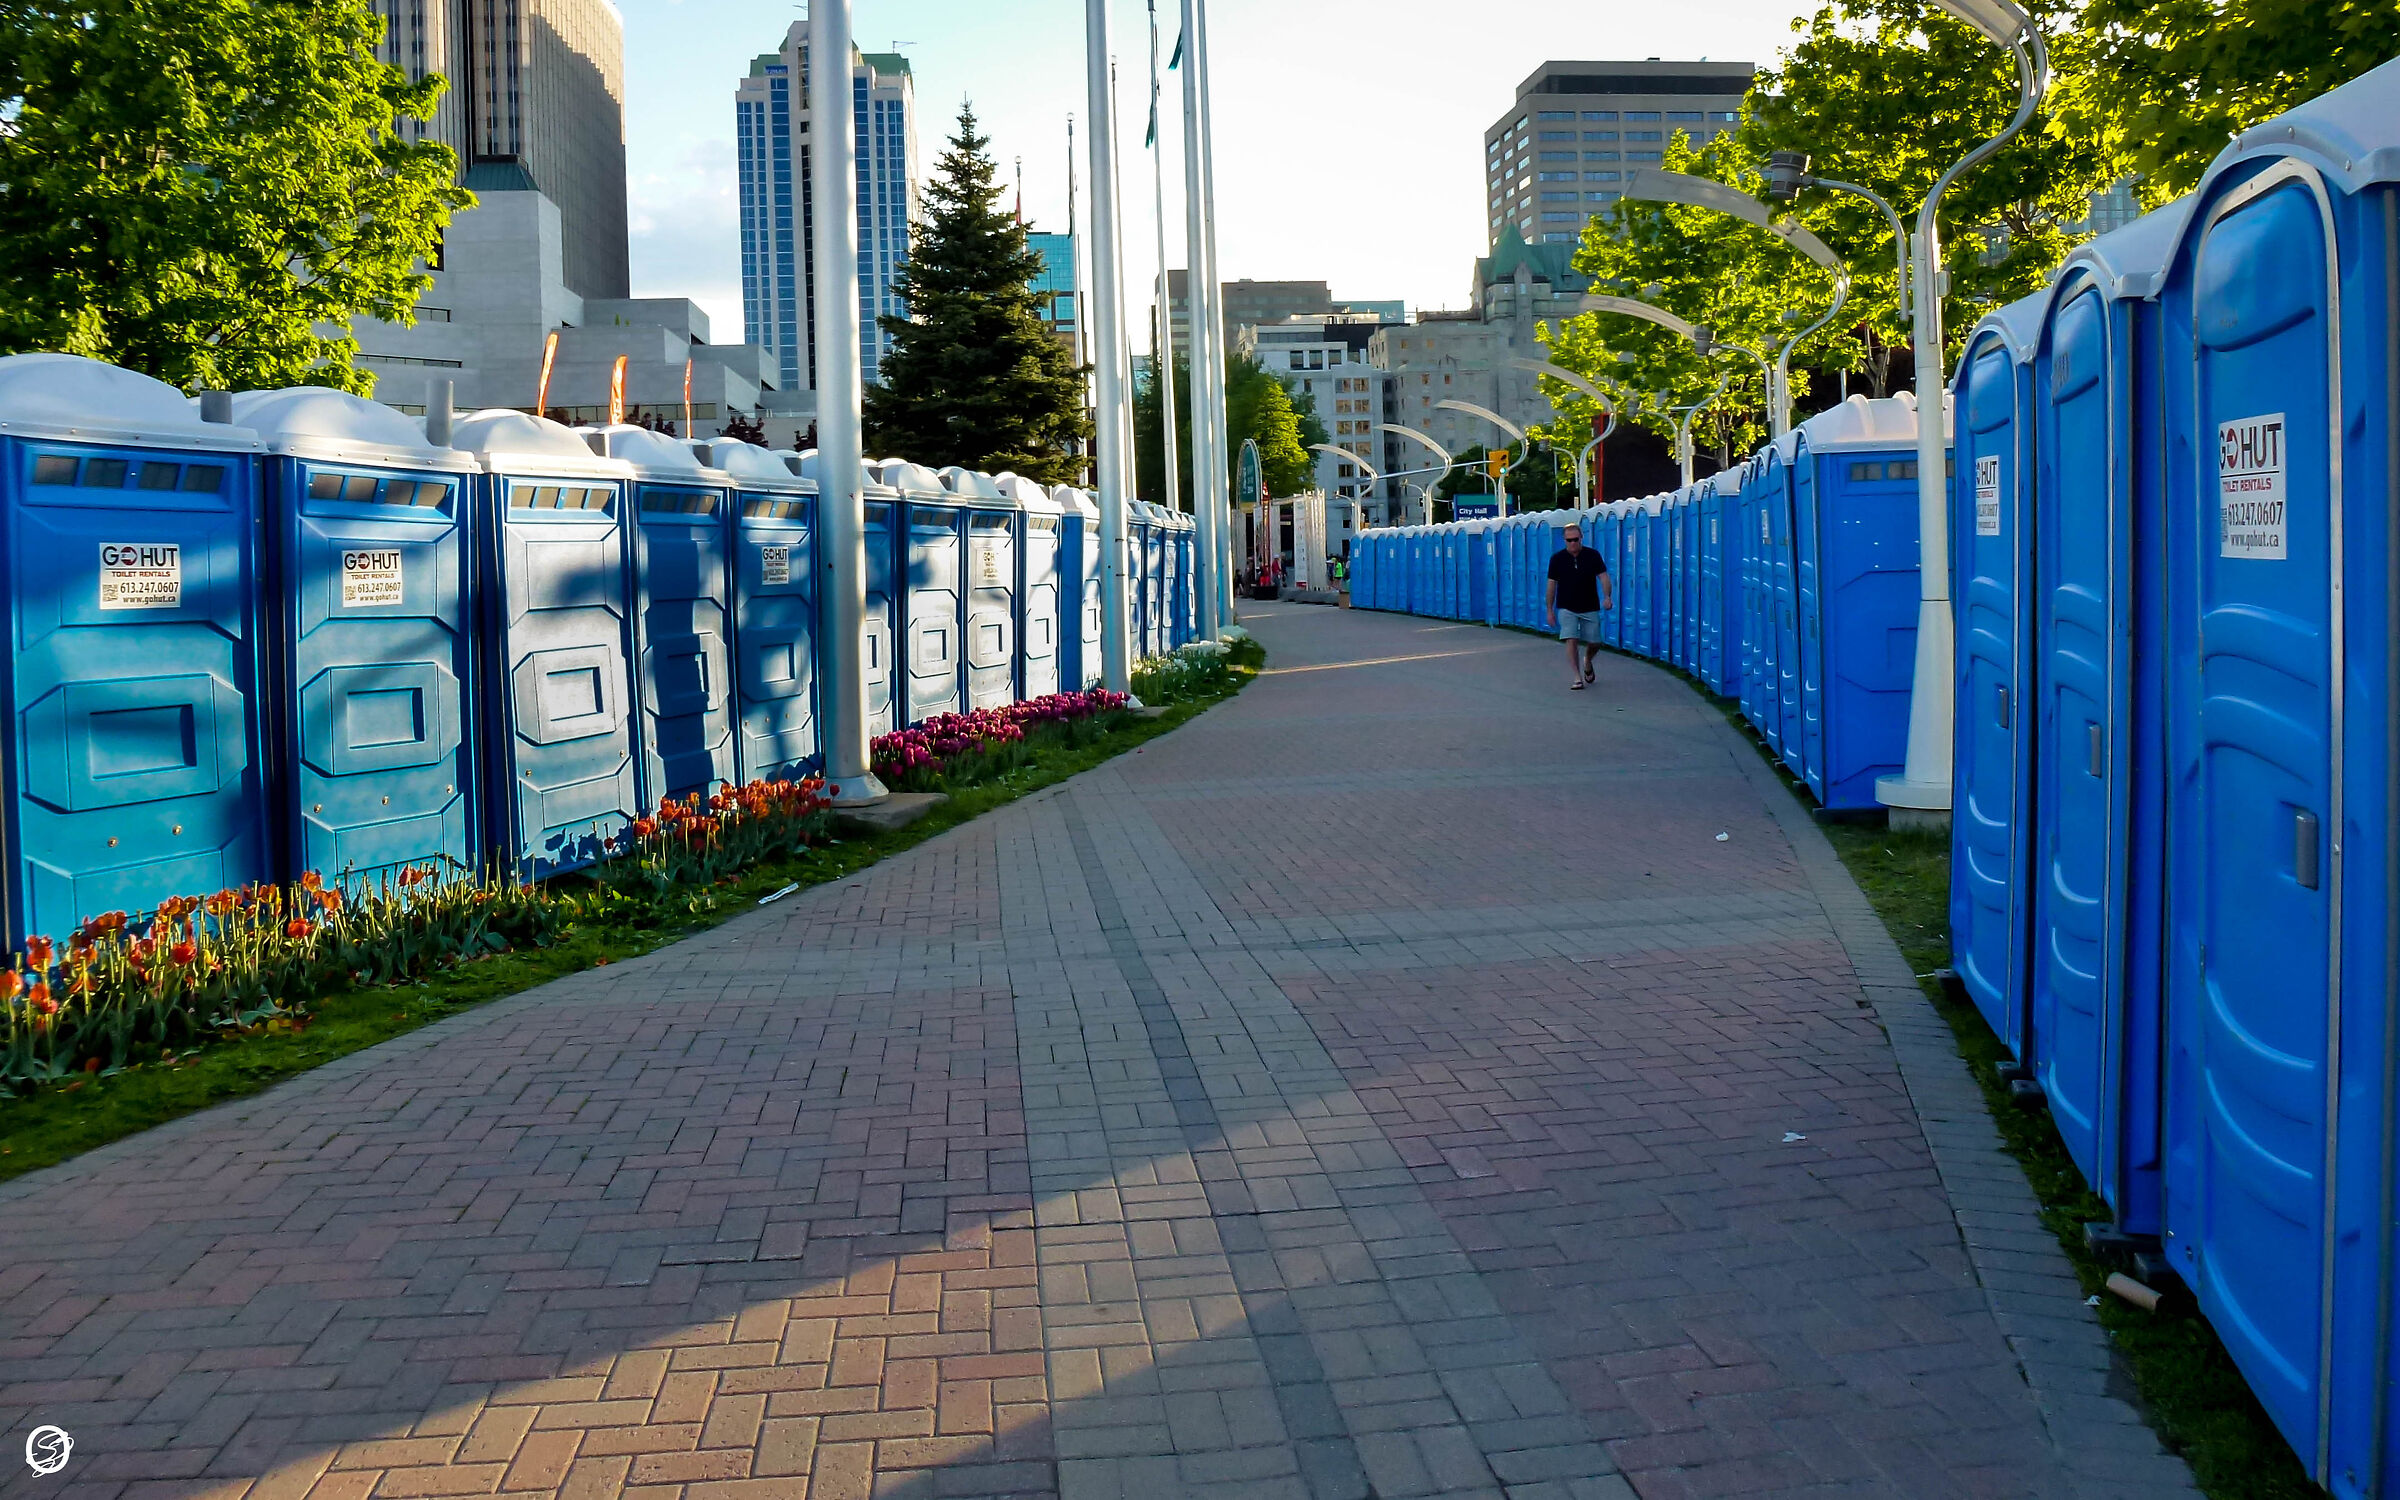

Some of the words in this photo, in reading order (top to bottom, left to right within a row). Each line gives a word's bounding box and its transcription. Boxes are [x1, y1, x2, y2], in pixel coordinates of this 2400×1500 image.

[2240, 477, 2272, 493] RENTALS
[2228, 501, 2283, 527] 613.247.0607
[2230, 529, 2279, 551] www.gohut.ca
[120, 581, 179, 594] 613.247.0607
[357, 582, 401, 594] 613.247.0607
[123, 594, 176, 605] www.gohut.ca
